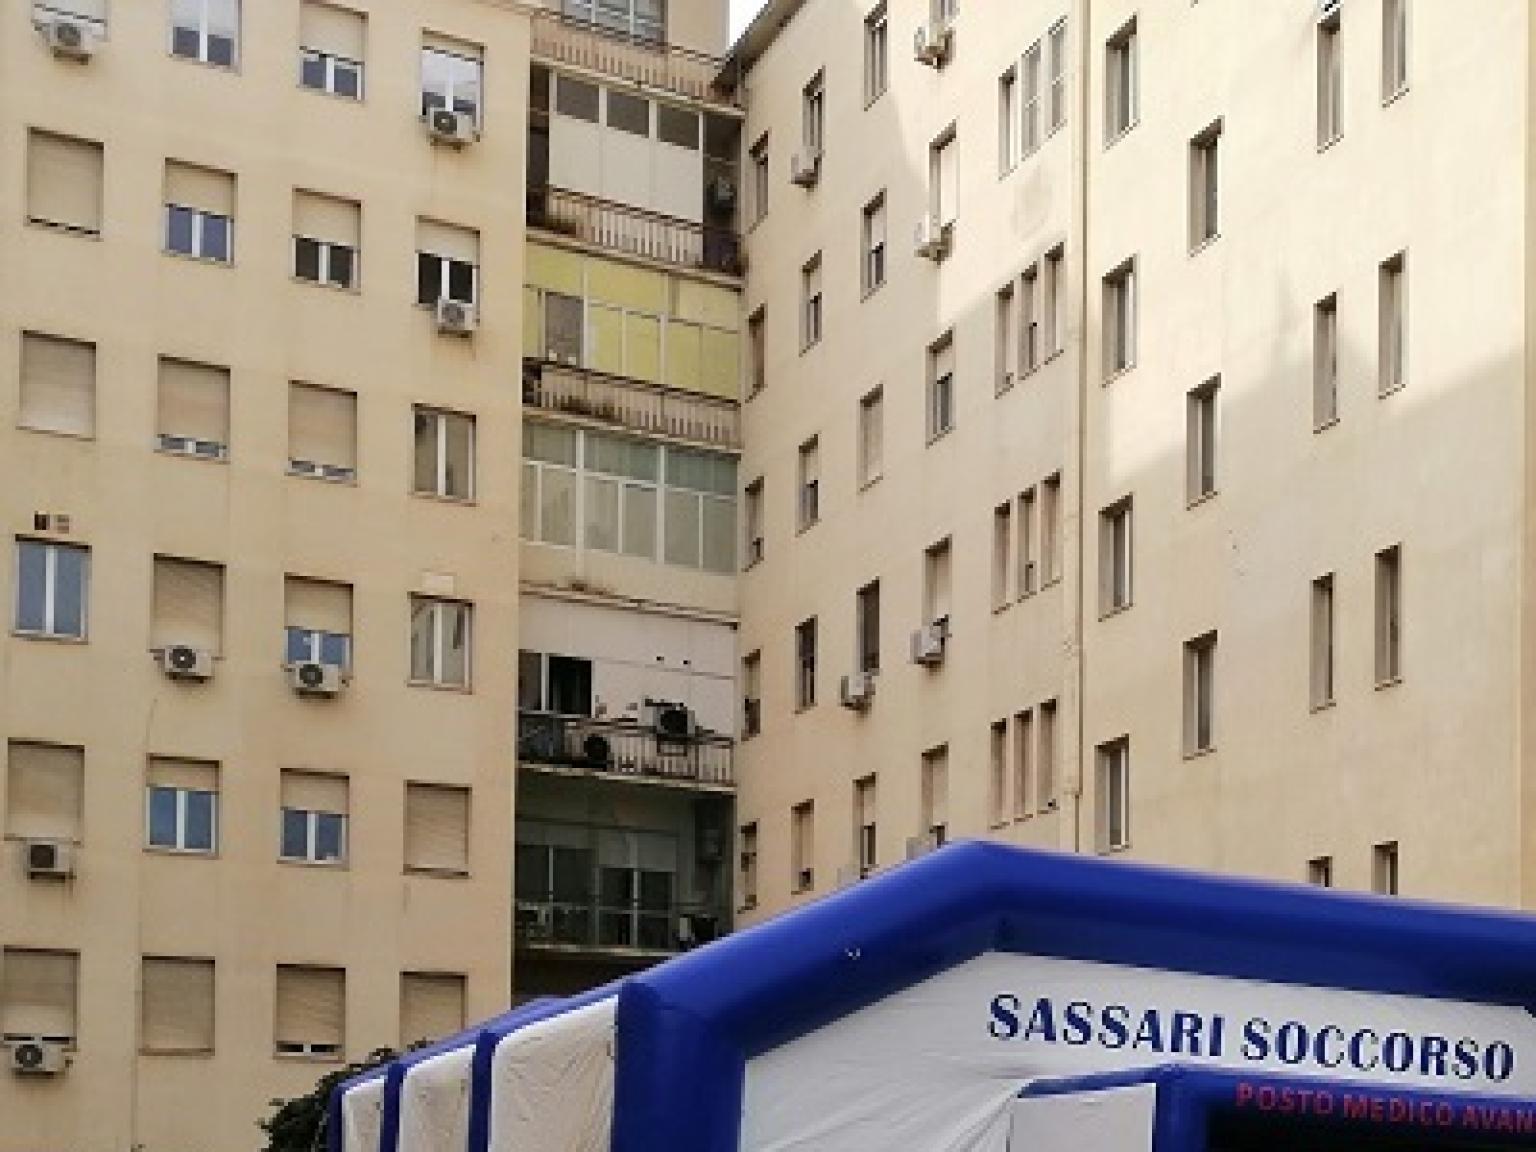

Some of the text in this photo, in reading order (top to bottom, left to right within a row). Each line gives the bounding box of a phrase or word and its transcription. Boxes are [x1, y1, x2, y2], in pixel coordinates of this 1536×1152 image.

[987, 992, 1514, 1081] SASSARI SOCCORSO
[1236, 1081, 1334, 1115] POSTO
[1343, 1093, 1453, 1126] MEDICO
